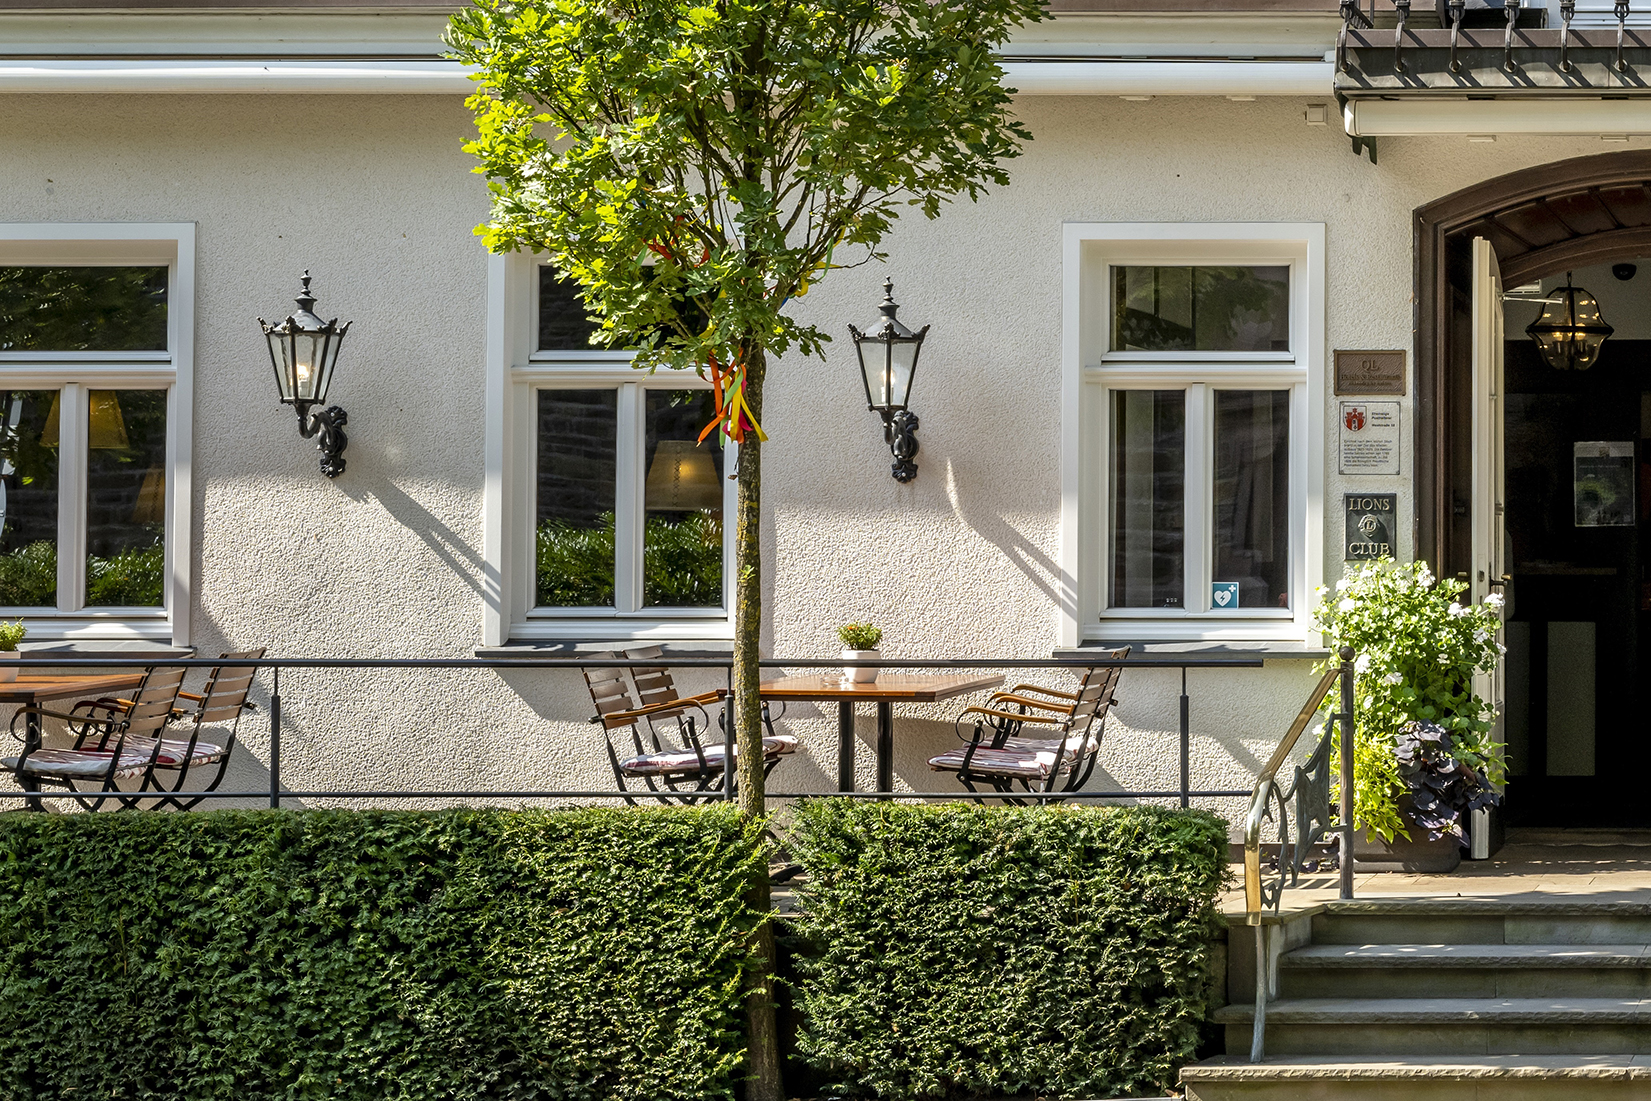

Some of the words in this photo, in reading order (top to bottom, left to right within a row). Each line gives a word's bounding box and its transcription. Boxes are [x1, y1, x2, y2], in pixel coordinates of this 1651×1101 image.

[1361, 360, 1380, 373] QL
[1349, 498, 1390, 511] LIONS
[1349, 542, 1390, 555] CLUB
